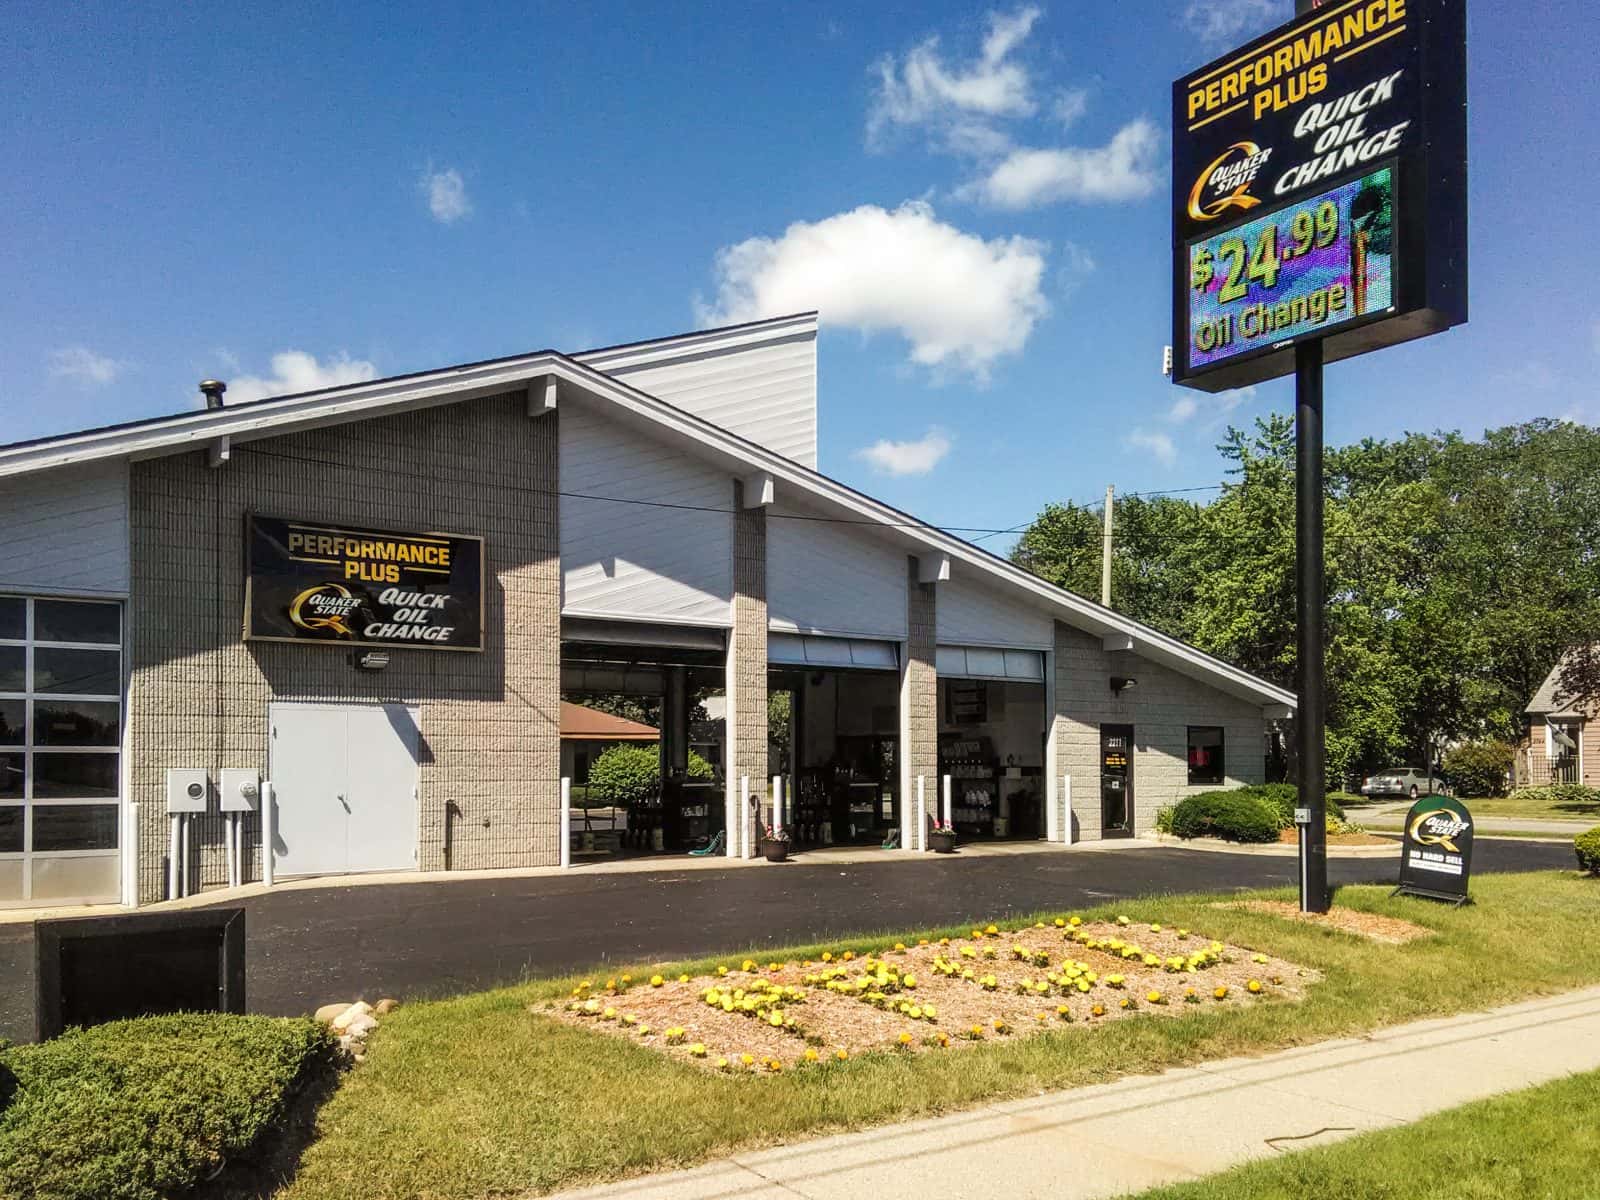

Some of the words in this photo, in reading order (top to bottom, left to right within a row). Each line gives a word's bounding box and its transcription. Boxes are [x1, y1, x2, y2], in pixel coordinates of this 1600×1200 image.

[1188, 0, 1406, 120] PERFORMANCE
[1254, 62, 1327, 121] PLUS
[1293, 68, 1403, 138] QUICK
[1313, 112, 1368, 154] OIL
[1208, 148, 1272, 186] QUAKER
[1273, 120, 1411, 195] CHANGE
[1214, 165, 1261, 196] STATE
[1196, 314, 1232, 352] Oil
[1238, 282, 1347, 337] Change
[288, 533, 450, 566] PERFORMANCE
[344, 560, 400, 583] PLUS
[309, 594, 362, 608] QUAKER
[314, 605, 353, 616] STATE
[378, 587, 453, 610] QUICK
[393, 608, 430, 624] OIL
[363, 623, 456, 641] CHANGE
[1425, 816, 1470, 831] QUAKER
[1428, 826, 1459, 836] STATE
